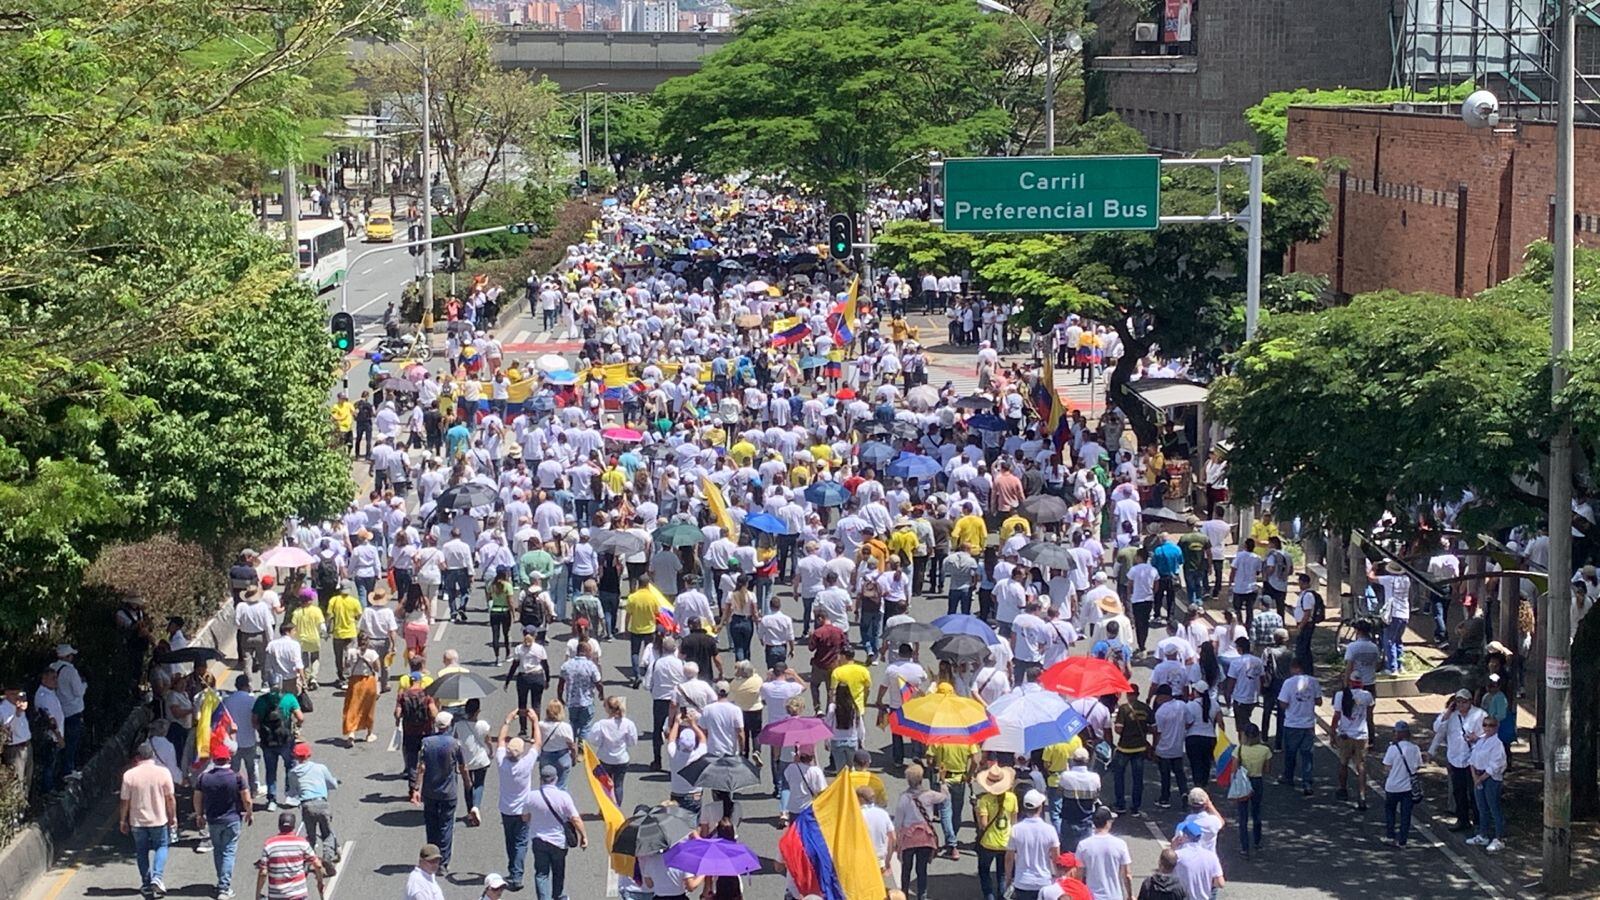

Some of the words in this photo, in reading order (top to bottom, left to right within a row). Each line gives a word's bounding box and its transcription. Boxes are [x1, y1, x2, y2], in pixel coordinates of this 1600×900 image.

[1019, 172, 1085, 190] Carril
[955, 201, 1093, 219] Preferencial
[1104, 199, 1147, 218] Bus
